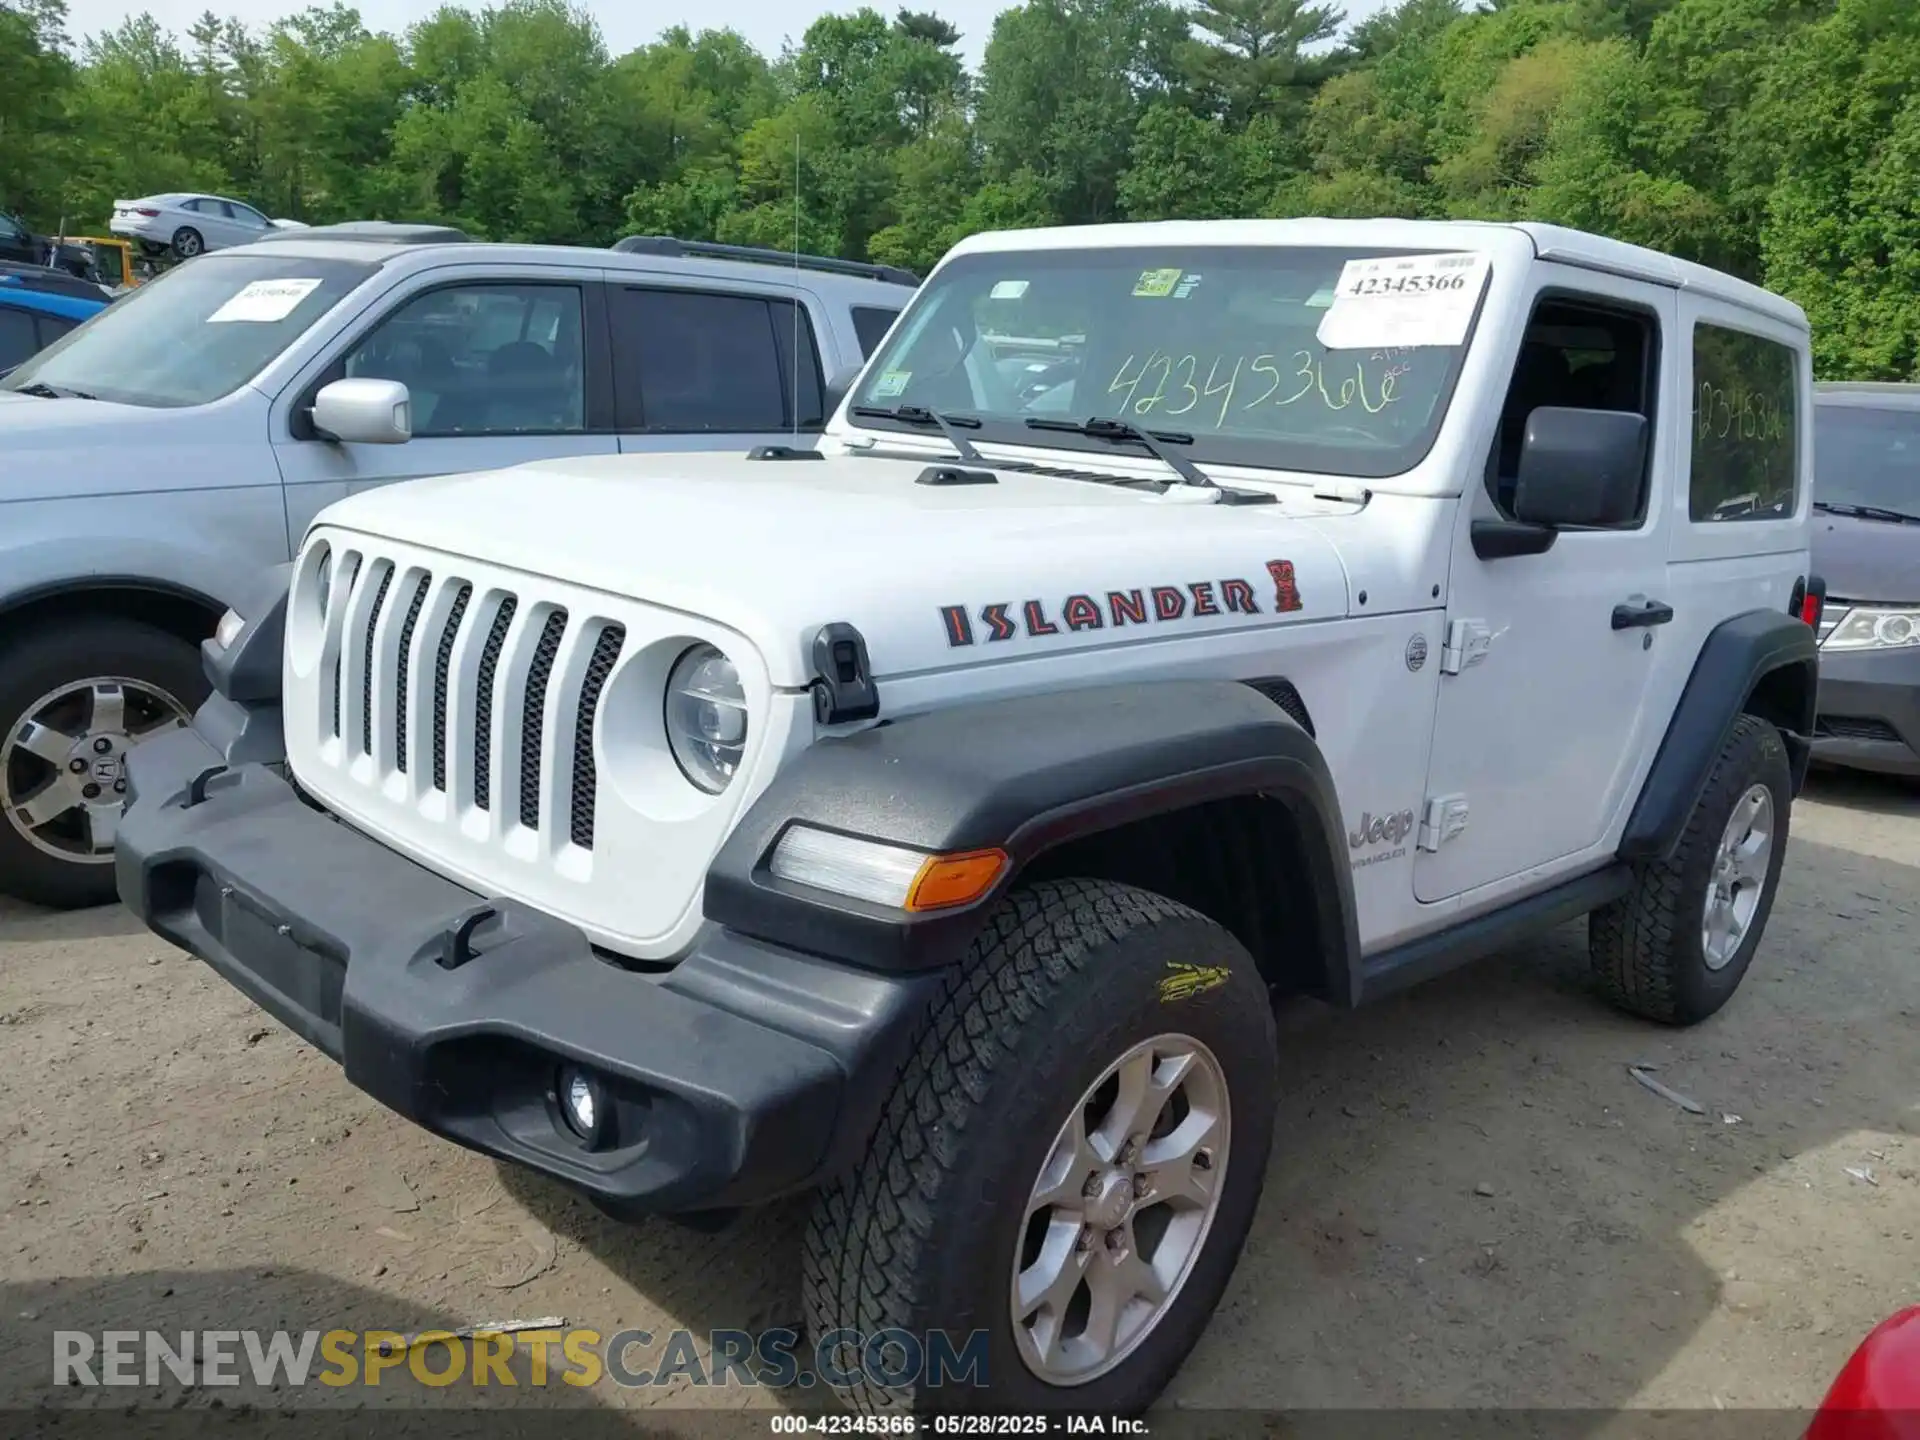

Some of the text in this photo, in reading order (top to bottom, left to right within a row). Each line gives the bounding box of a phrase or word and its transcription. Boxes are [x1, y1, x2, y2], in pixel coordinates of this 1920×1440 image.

[1349, 273, 1465, 295] 42345366
[1108, 350, 1401, 429] 42345366
[939, 579, 1260, 647] ISLANDER
[1349, 809, 1414, 849] Jeep
